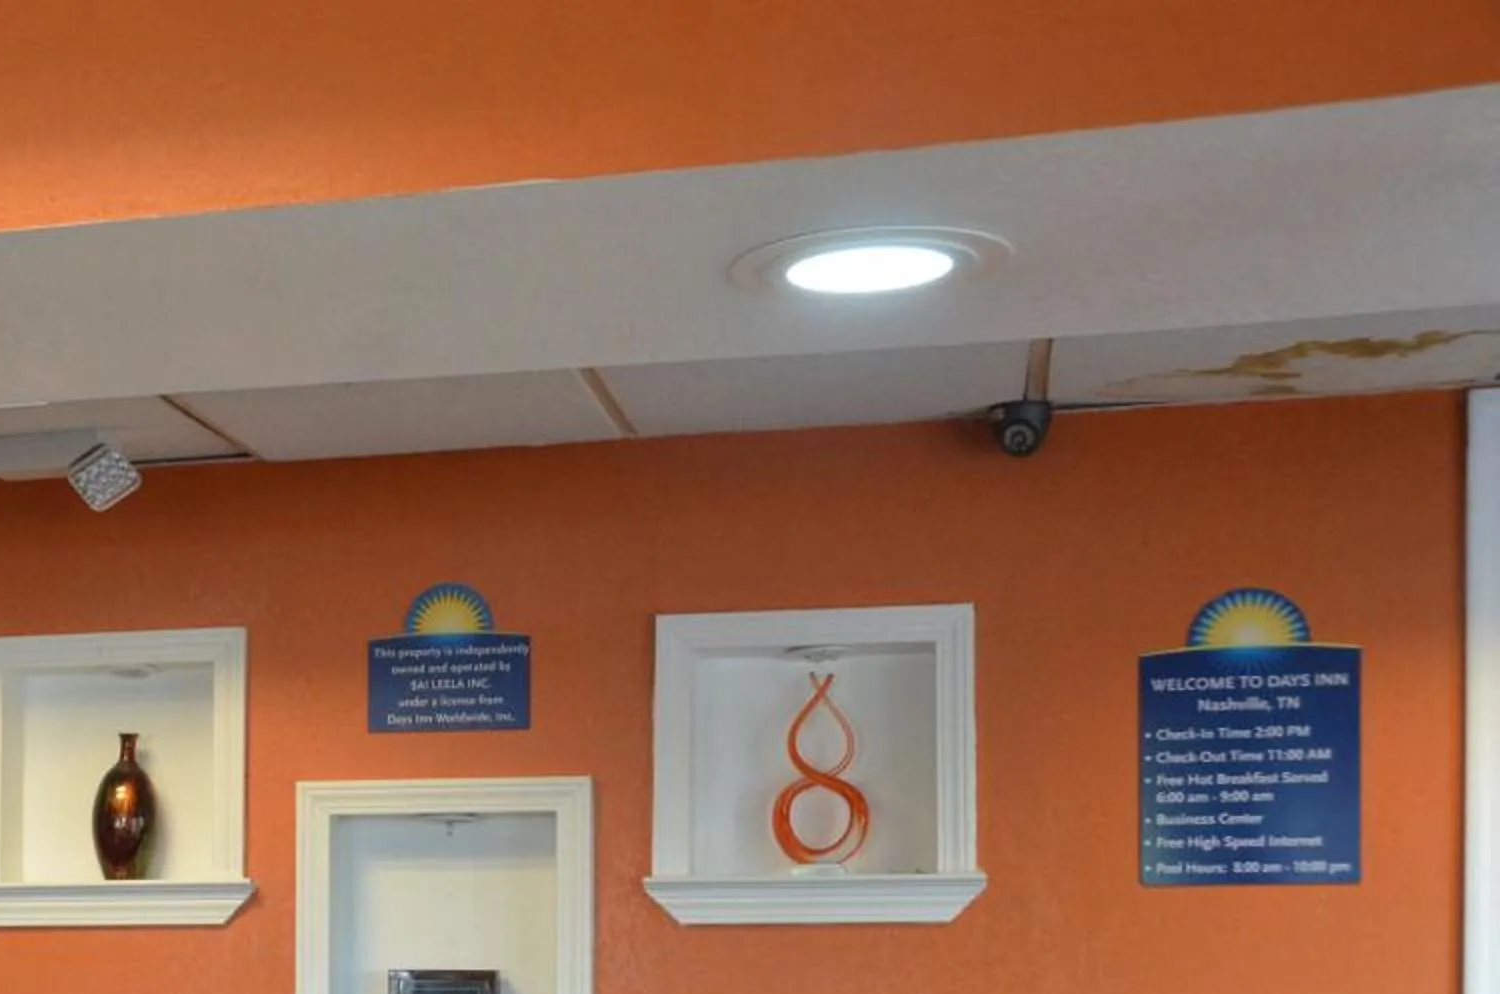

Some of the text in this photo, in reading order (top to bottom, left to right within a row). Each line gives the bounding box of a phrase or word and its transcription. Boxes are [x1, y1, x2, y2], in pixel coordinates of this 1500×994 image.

[375, 643, 529, 660] This property is independently
[392, 661, 510, 675] owned and operated by
[431, 679, 464, 690] LEELA
[1151, 672, 1349, 692] WELCOME TO DAYS INN
[397, 694, 503, 707] under a license from
[1276, 696, 1300, 711] TN
[387, 713, 412, 726] Days
[415, 713, 433, 724] Inn
[1156, 725, 1311, 741] Check-In Time 2:00 PM
[1156, 749, 1227, 764] Check-Out
[1231, 748, 1263, 763] Time
[1307, 748, 1332, 761] AM
[1156, 769, 1329, 787] Free Hot Breakfast Served
[1187, 793, 1208, 804] am
[1252, 791, 1274, 802] am
[1156, 812, 1263, 827] Business Center
[1156, 834, 1323, 852] Free High Speed Internet
[1156, 861, 1182, 875] Pool
[1262, 862, 1282, 873] am
